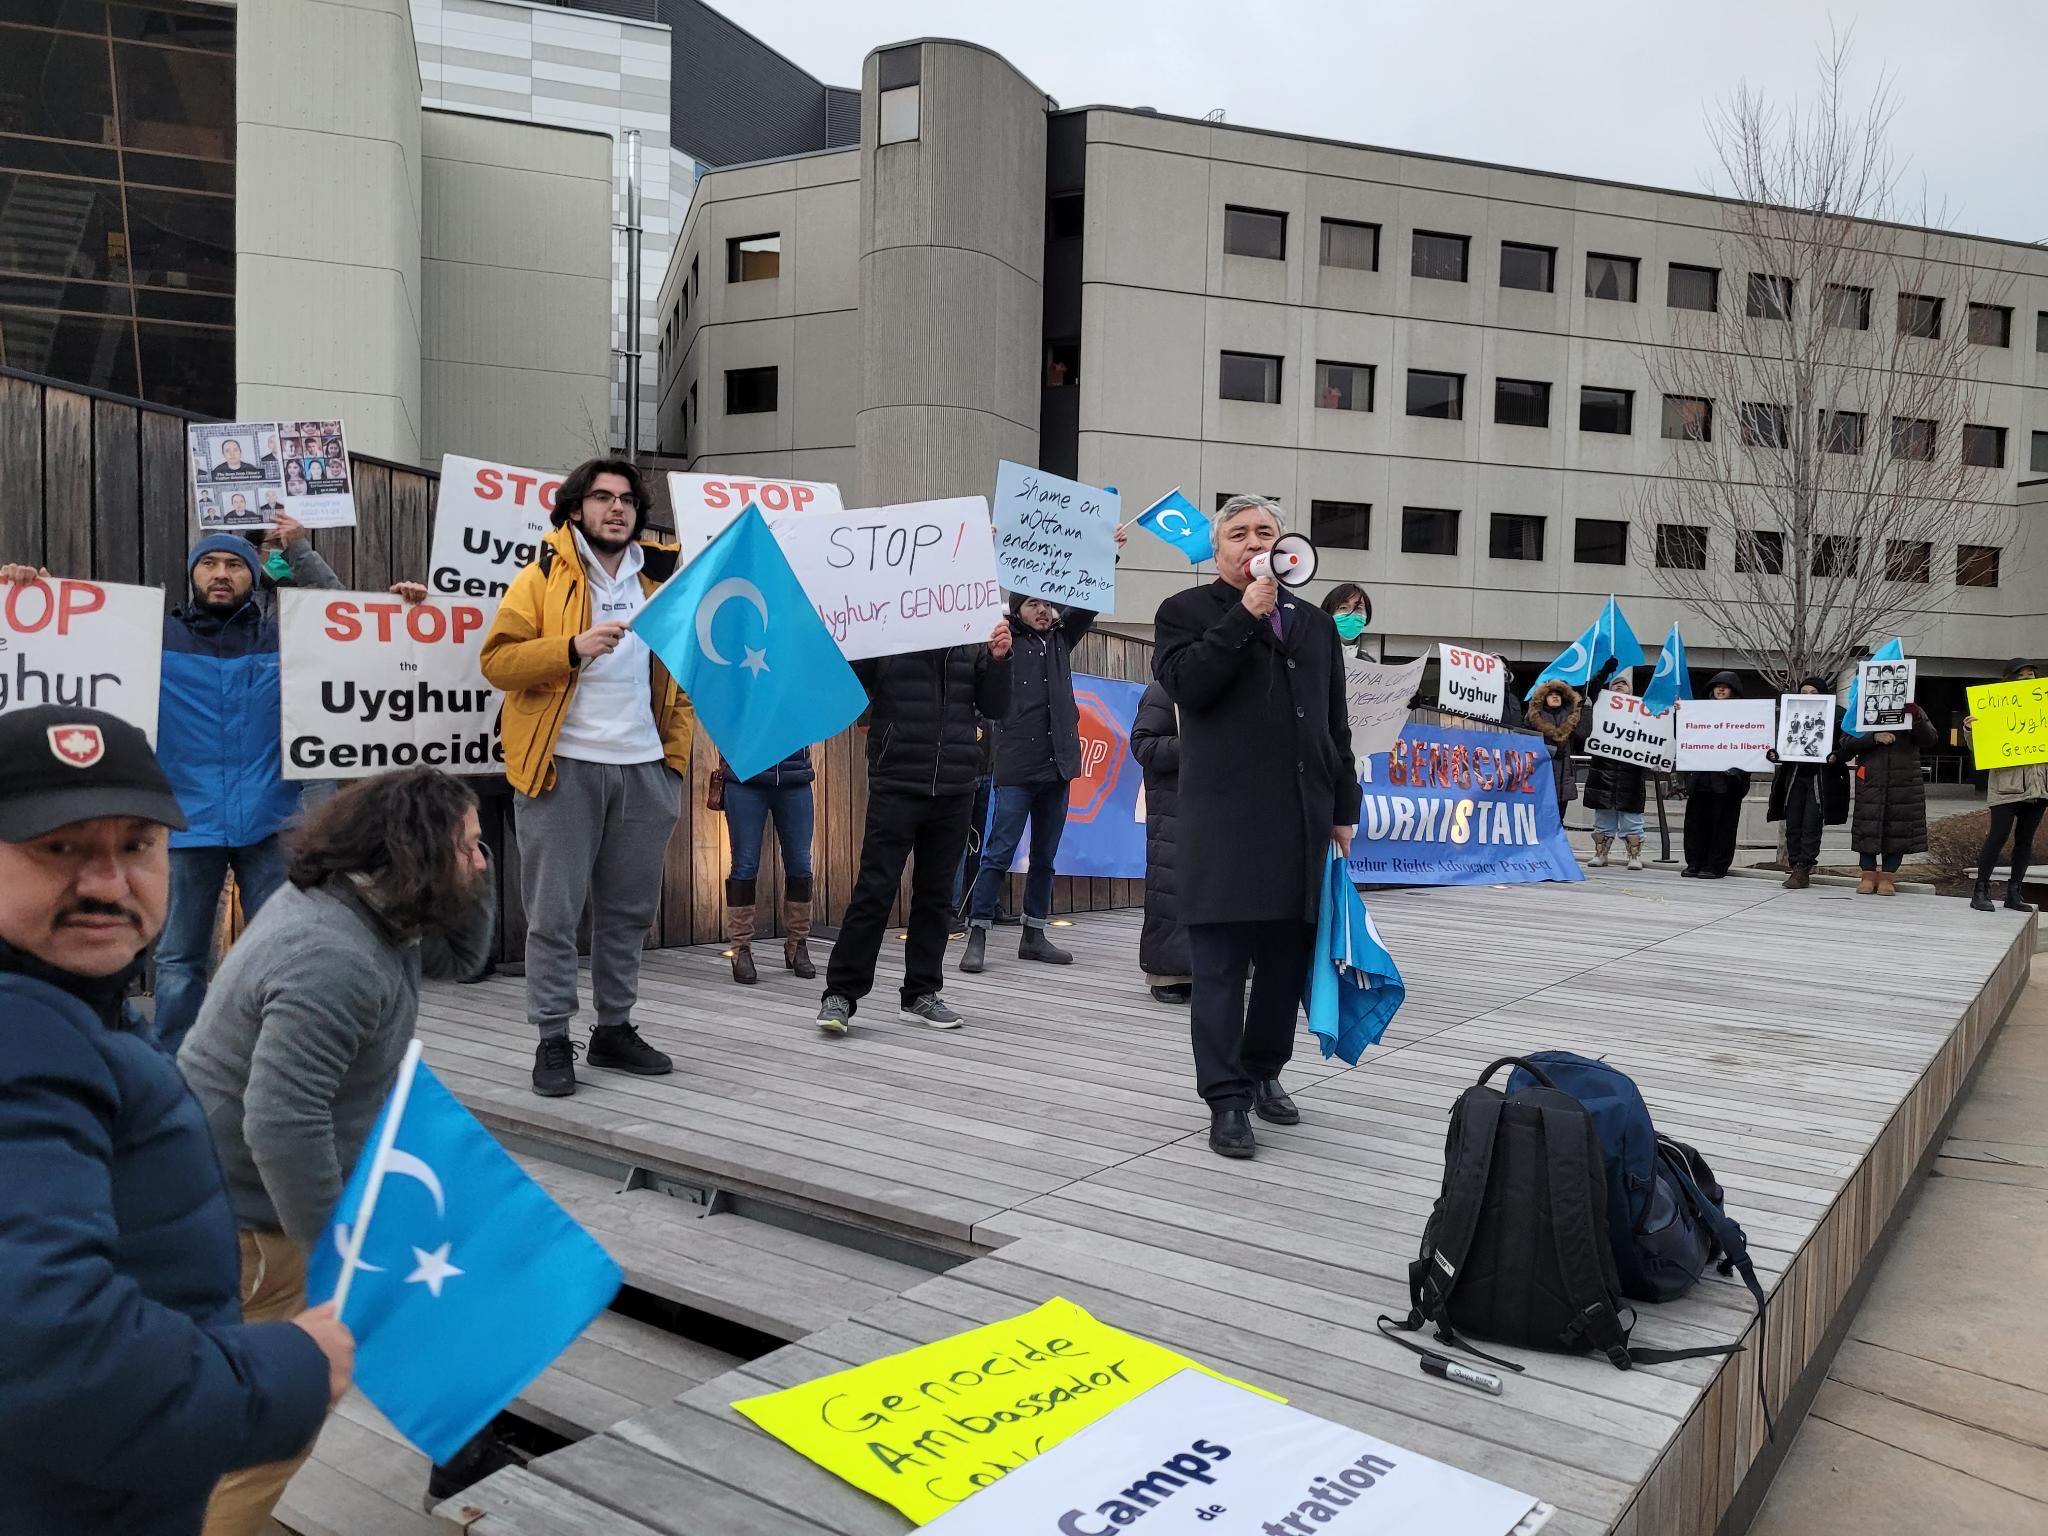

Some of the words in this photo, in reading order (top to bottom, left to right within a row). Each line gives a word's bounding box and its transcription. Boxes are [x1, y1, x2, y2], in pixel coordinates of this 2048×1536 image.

[703, 481, 815, 512] STOP
[1015, 477, 1071, 509] Shame
[1080, 501, 1101, 518] on
[1003, 531, 1073, 568] endorsing
[1015, 575, 1029, 587] on
[1040, 581, 1090, 602] campus
[1077, 570, 1114, 590] Denier
[900, 580, 999, 619] GENOCIDE
[325, 601, 484, 644] STOP
[400, 661, 418, 672] the
[1450, 649, 1495, 673] STOP
[321, 681, 492, 722] Uyghur
[1449, 680, 1498, 704] Uyghur
[1602, 720, 1667, 747] Uyghur
[1685, 722, 1712, 730] Flame
[1714, 722, 1724, 730] of
[1726, 722, 1765, 730] Freedom
[1389, 739, 1538, 793] GENOCIDE
[1587, 737, 1671, 769] Genocide
[1351, 794, 1540, 845] URKISTAN
[1392, 857, 1435, 875] Rights
[1437, 859, 1496, 875] Advocacy
[821, 1338, 1090, 1432] Genocide
[866, 1359, 1131, 1474] Ambassador
[1057, 1439, 1231, 1536] Camps
[1195, 1504, 1227, 1521] de
